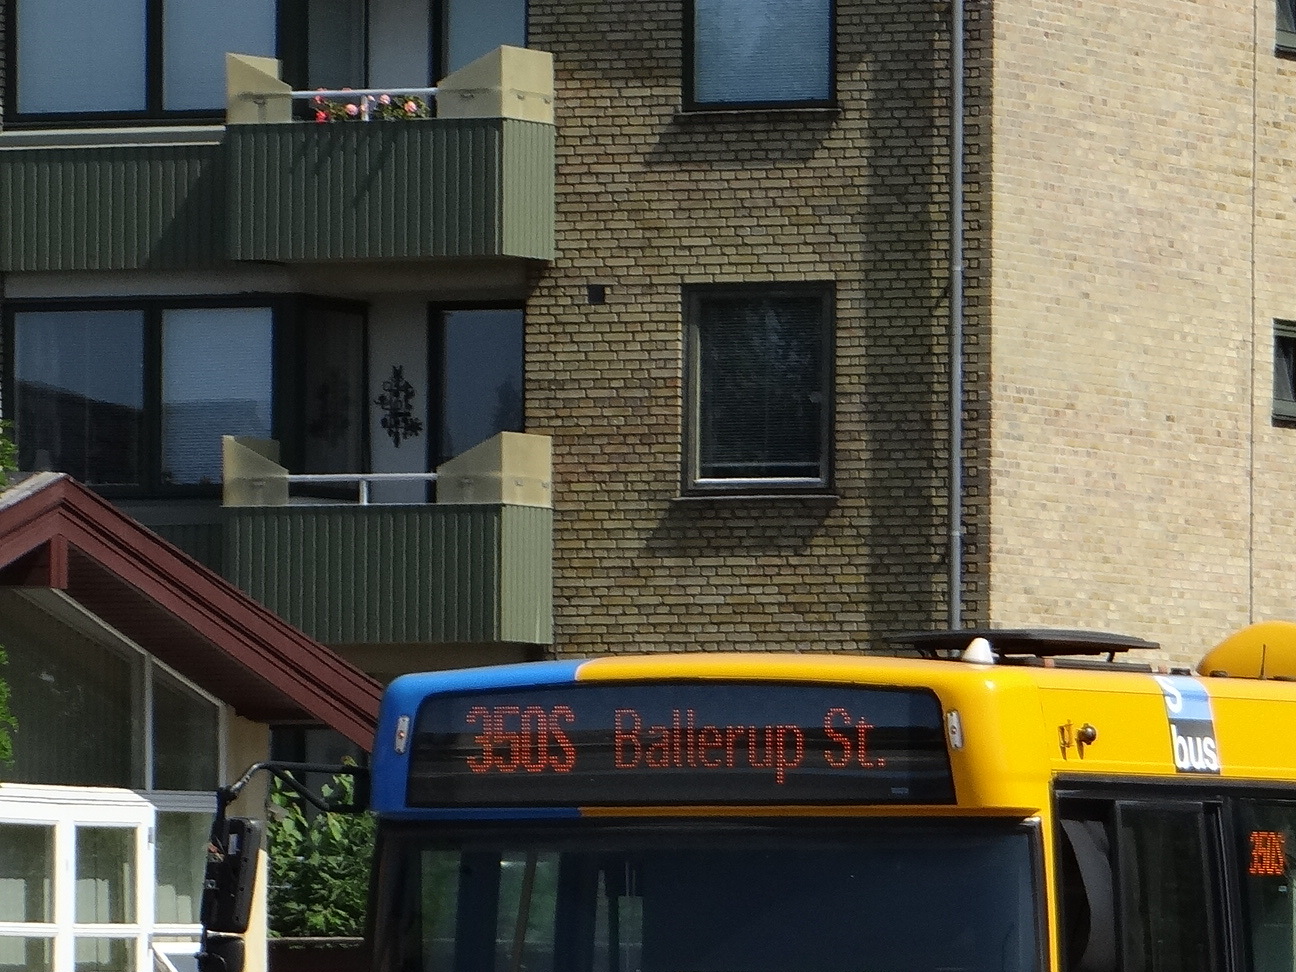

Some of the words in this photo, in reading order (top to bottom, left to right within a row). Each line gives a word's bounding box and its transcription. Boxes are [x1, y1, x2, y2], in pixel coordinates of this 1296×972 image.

[466, 705, 576, 773] 350S
[613, 708, 804, 785] Ballerup
[823, 706, 888, 770] St.
[1170, 723, 1219, 771] bus
